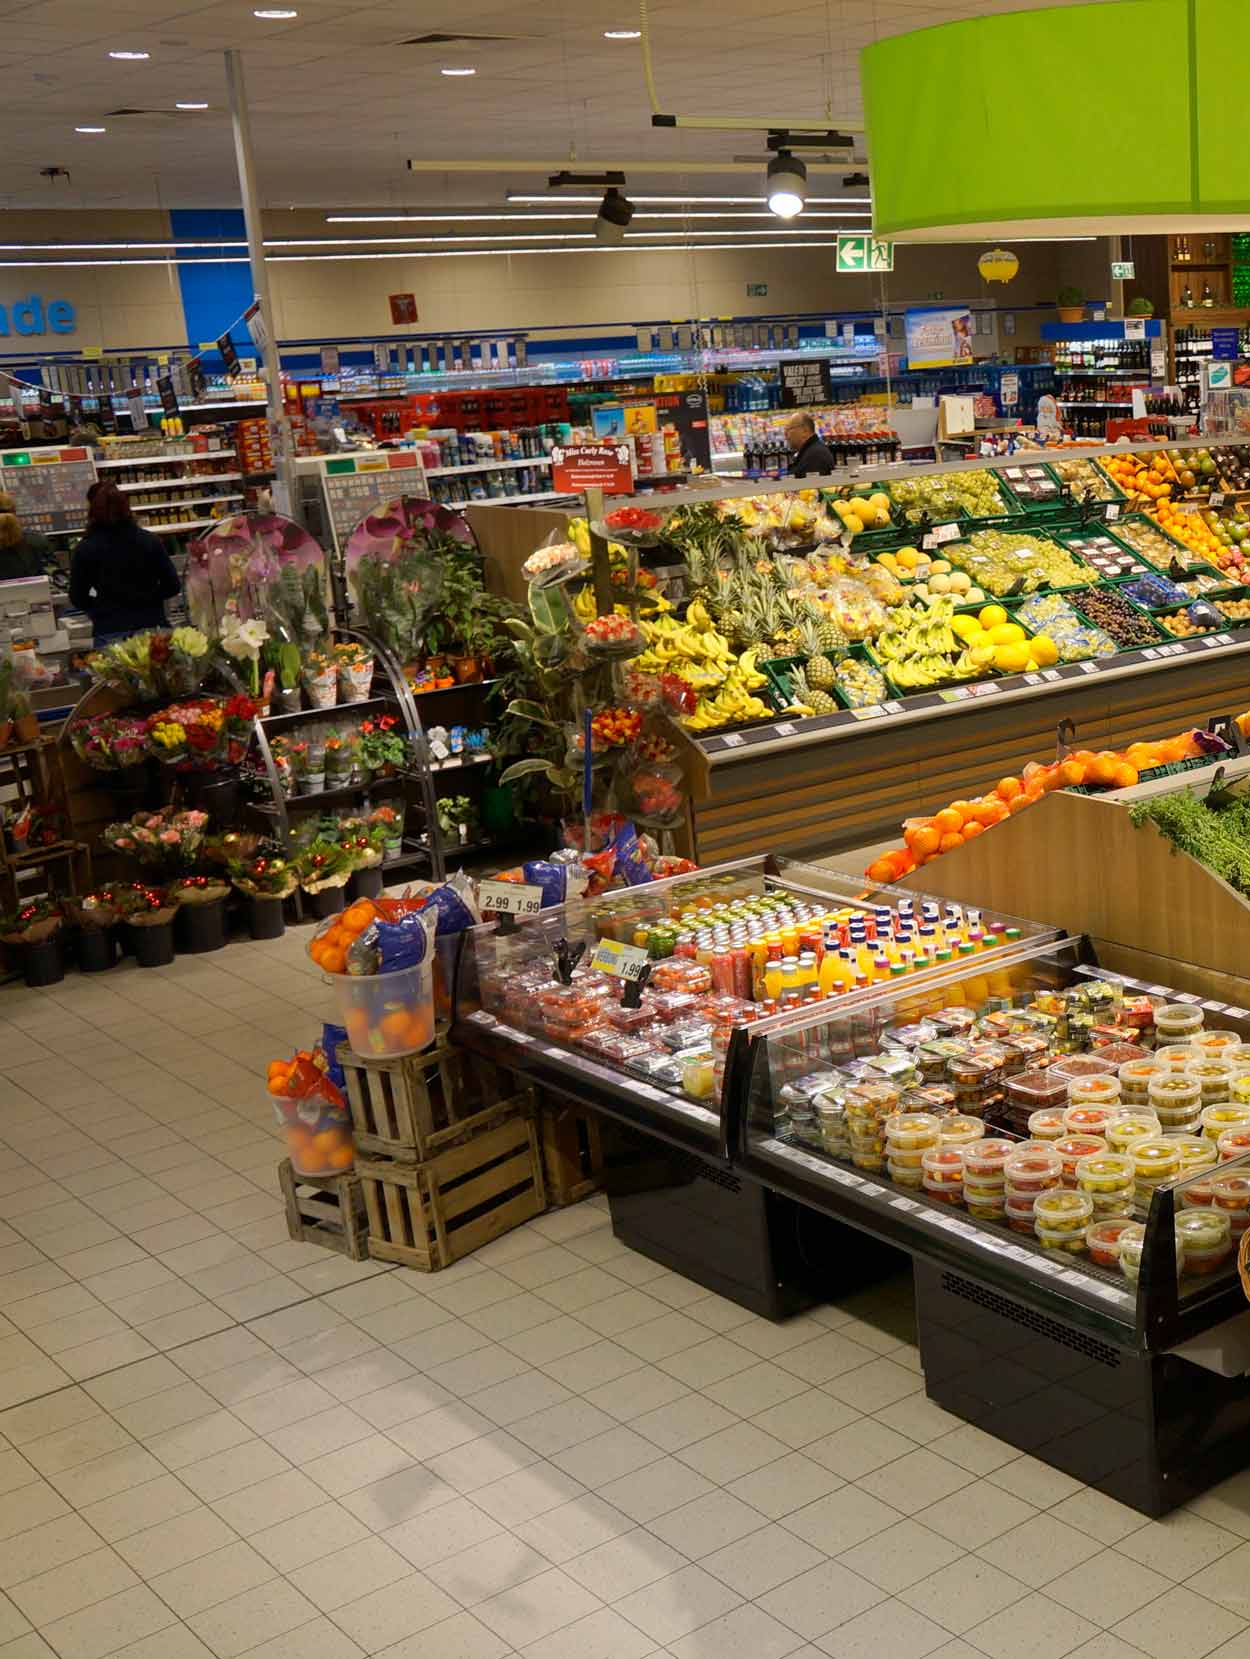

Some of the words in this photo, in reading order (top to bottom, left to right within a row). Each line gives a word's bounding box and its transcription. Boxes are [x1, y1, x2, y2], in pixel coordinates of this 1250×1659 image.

[485, 895, 510, 909] 2.99
[517, 900, 540, 913] 1.99
[621, 961, 641, 977] 1.99
